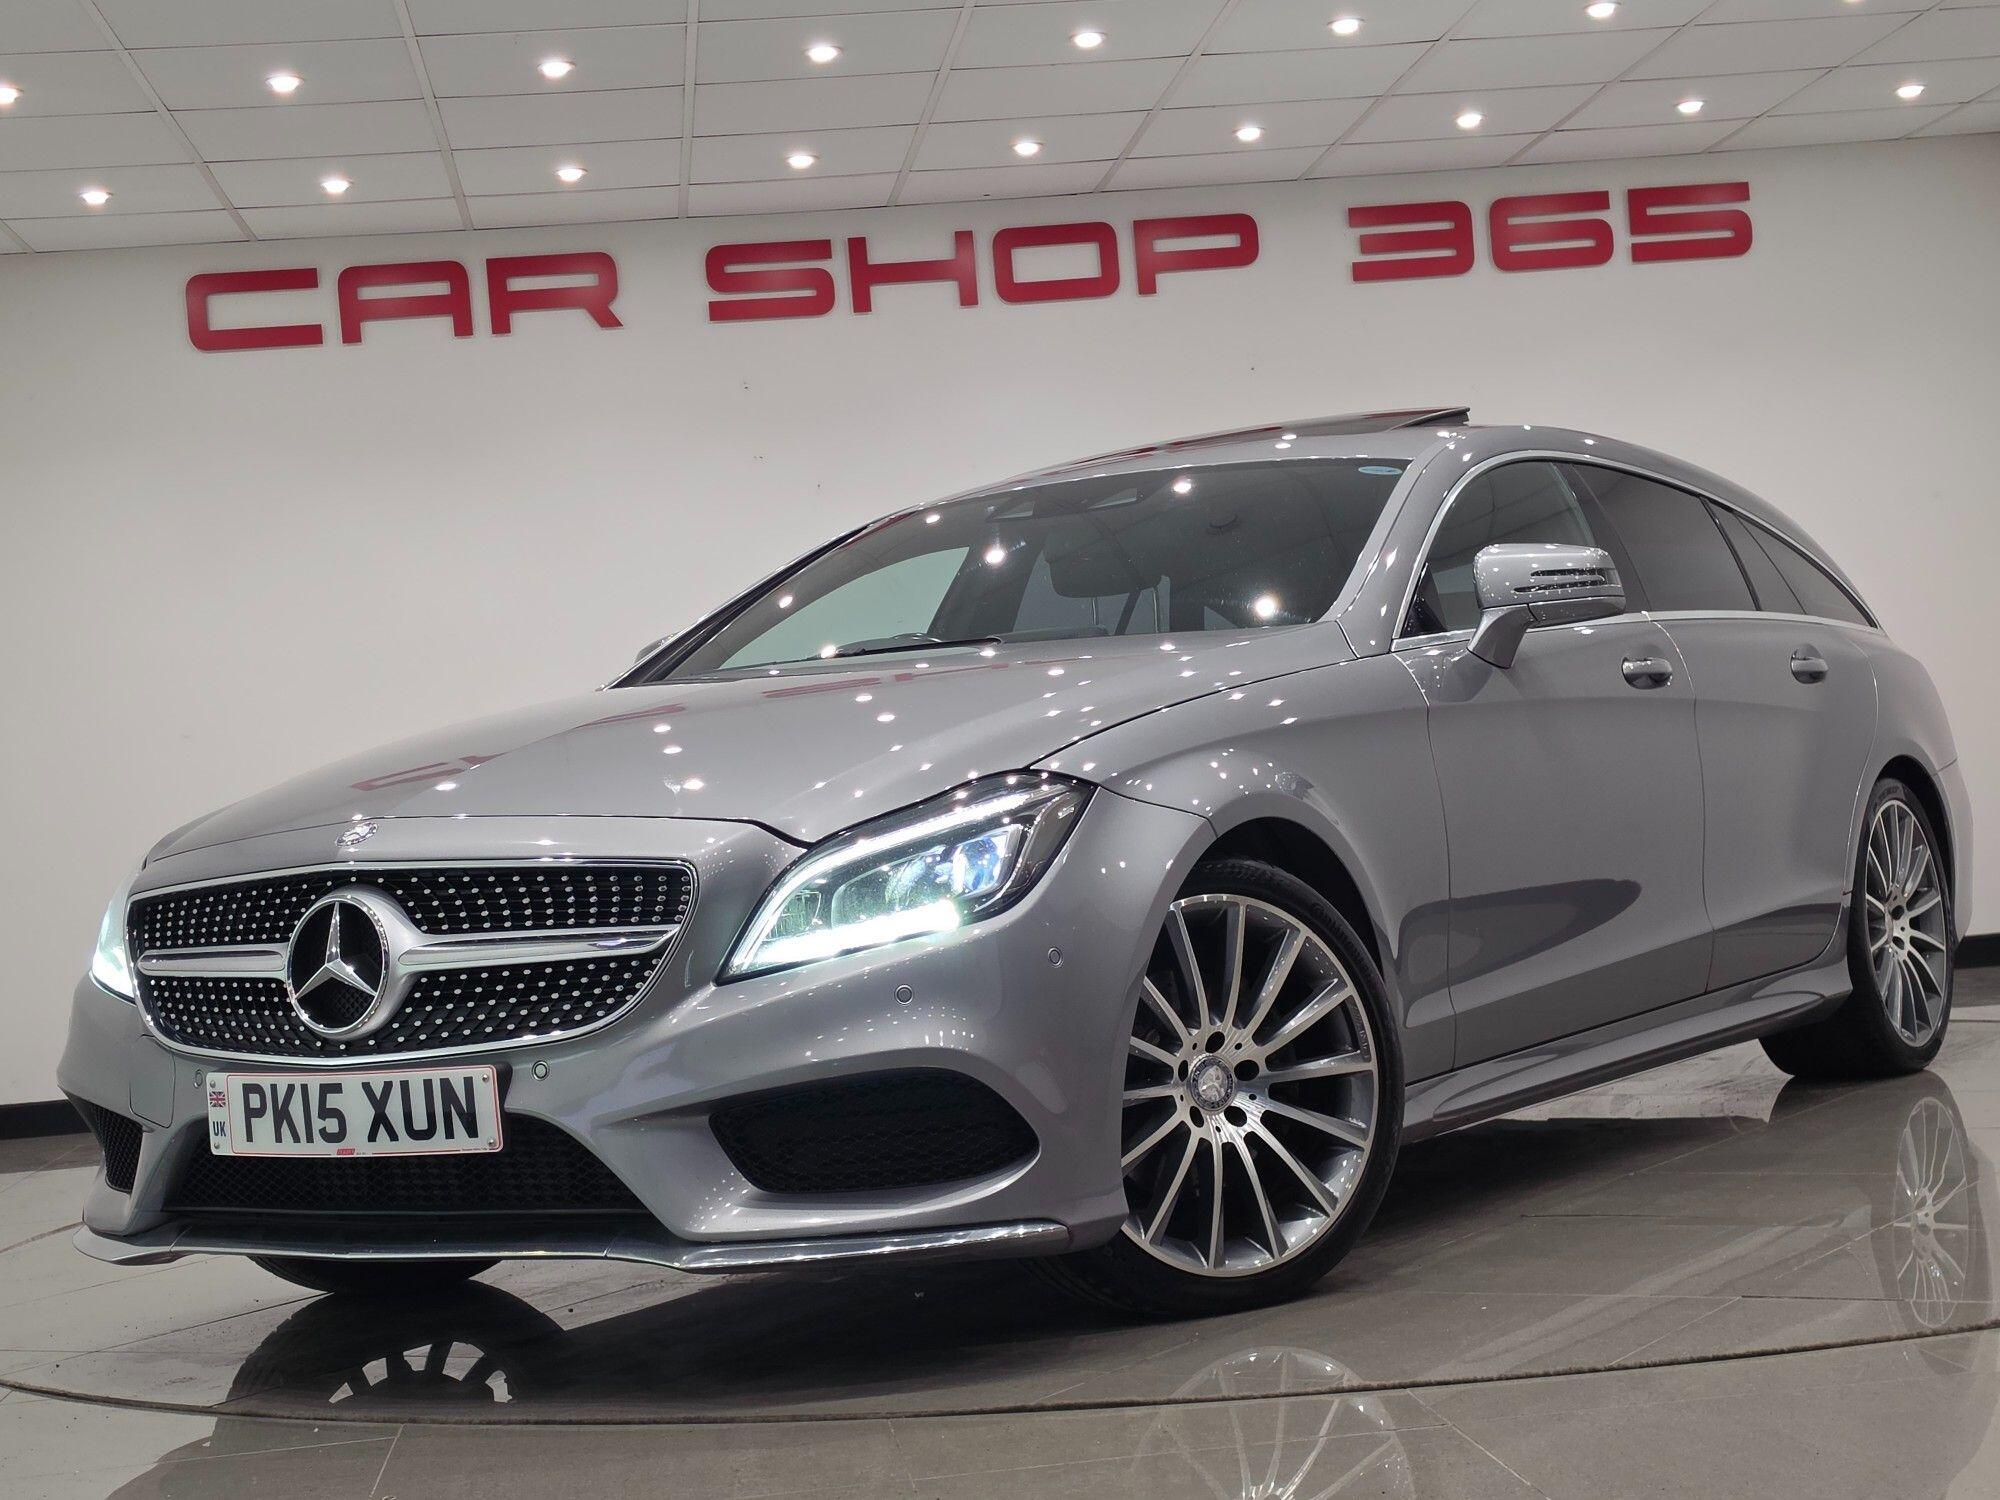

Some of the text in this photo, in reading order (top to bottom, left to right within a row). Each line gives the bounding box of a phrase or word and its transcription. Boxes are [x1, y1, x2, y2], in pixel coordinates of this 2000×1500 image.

[187, 182, 1753, 352] CAR SHOP 365
[212, 1120, 227, 1137] UK
[241, 1076, 479, 1144] PK15 XUN
